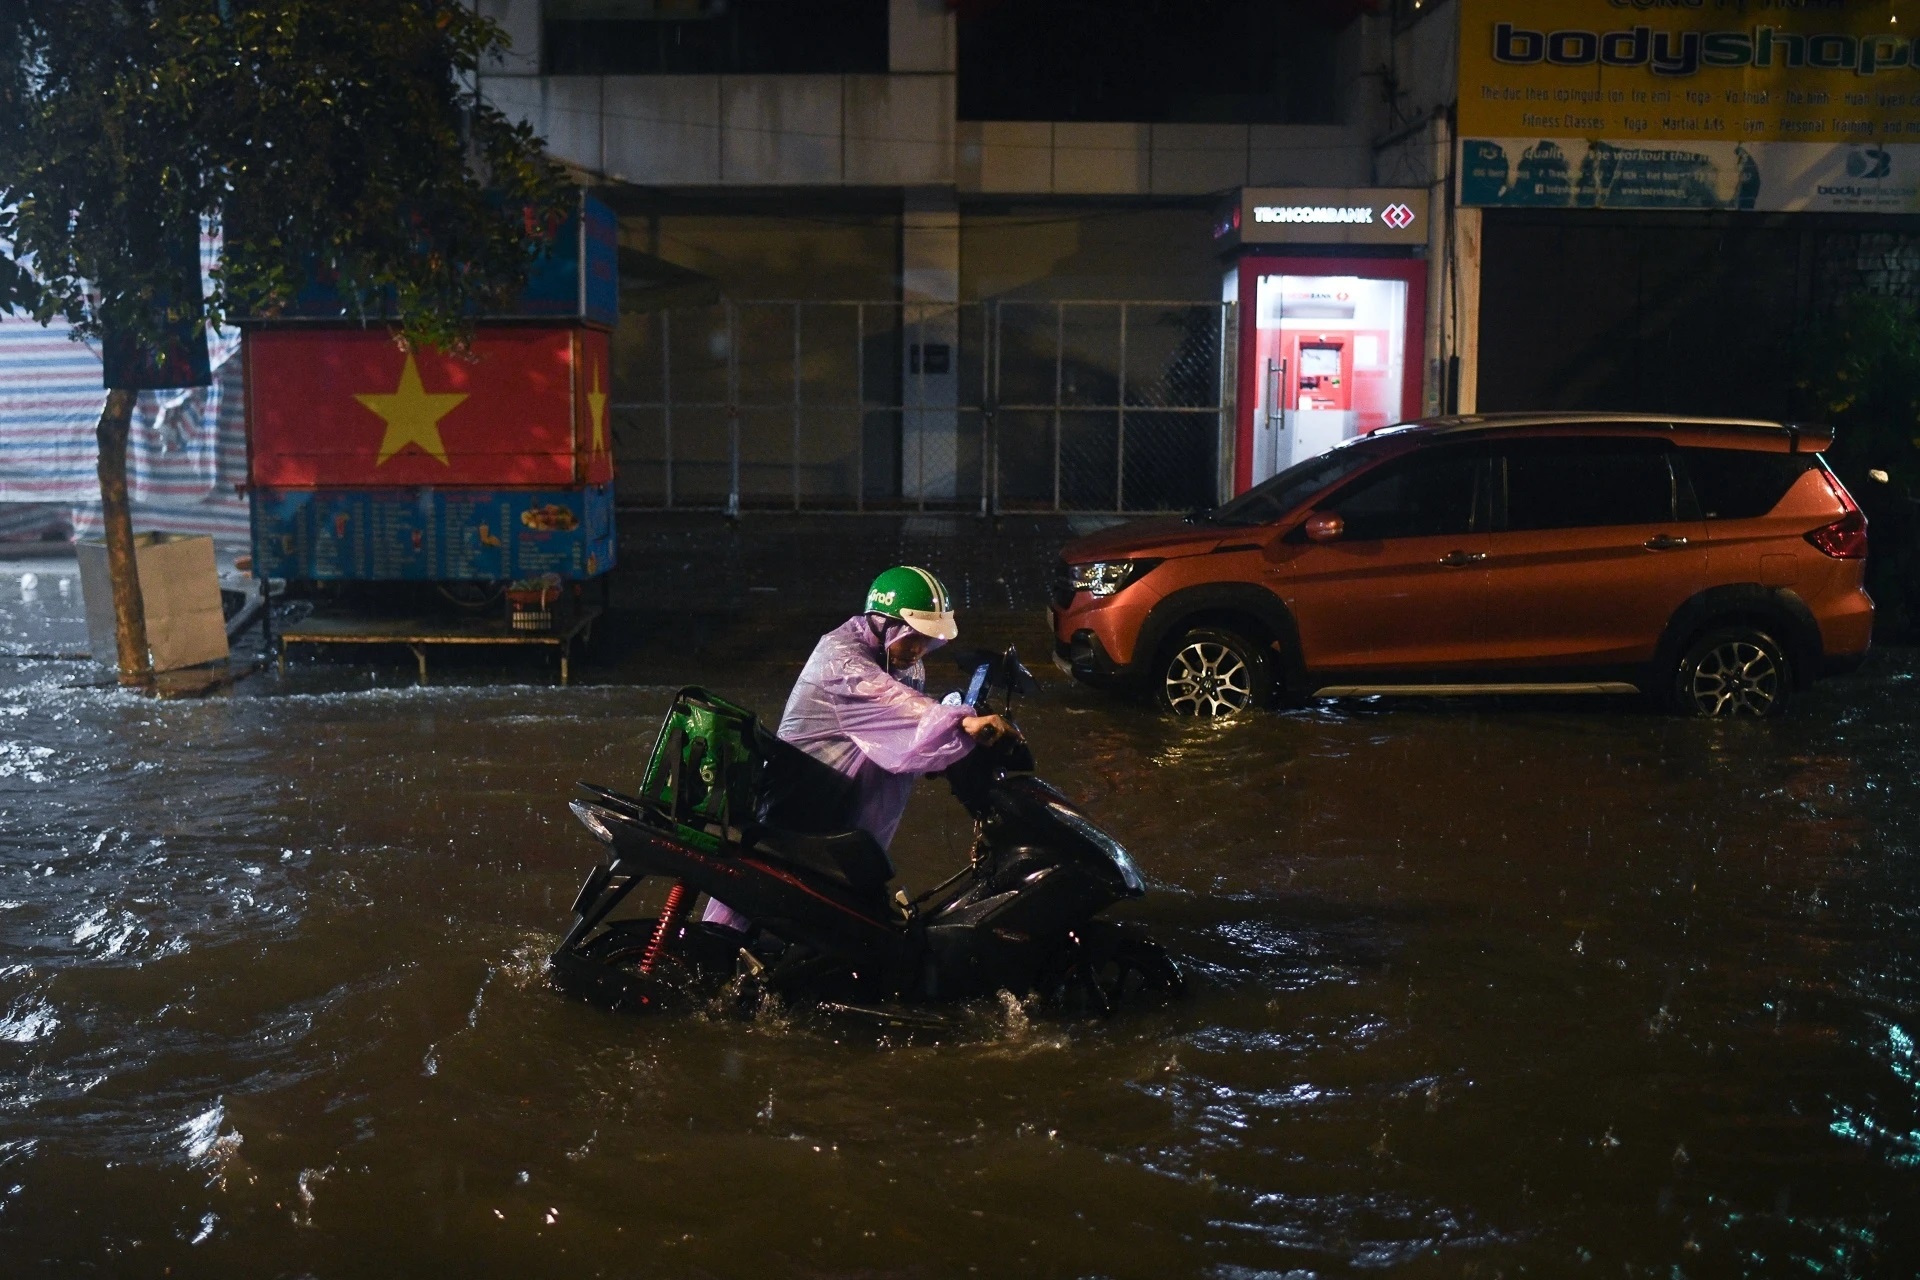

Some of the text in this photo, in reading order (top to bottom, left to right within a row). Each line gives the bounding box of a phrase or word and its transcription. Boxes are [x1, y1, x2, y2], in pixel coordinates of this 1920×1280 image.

[1493, 22, 1920, 78] bodyshap
[1522, 114, 1560, 128] Fitness
[1564, 114, 1605, 129] Classes
[1624, 116, 1648, 132] Yoga
[1663, 118, 1699, 130] Martial
[1779, 119, 1825, 132] Personal
[1832, 119, 1874, 135] Training
[1883, 121, 1902, 133] and
[1613, 150, 1666, 162] workout
[1670, 151, 1695, 162] that
[1254, 207, 1373, 223] TECHCOMBANK
[868, 589, 895, 606] Grab
